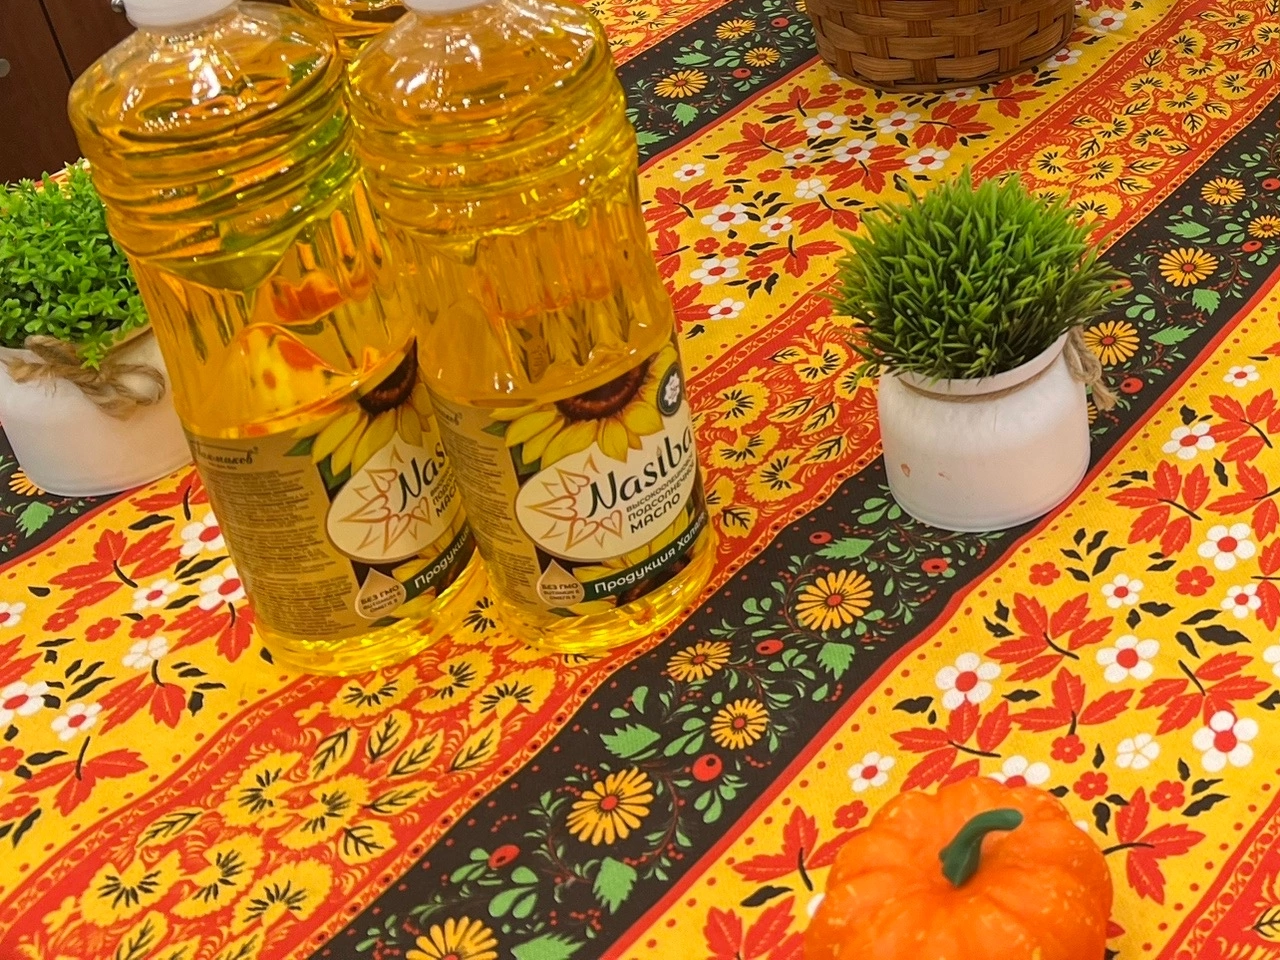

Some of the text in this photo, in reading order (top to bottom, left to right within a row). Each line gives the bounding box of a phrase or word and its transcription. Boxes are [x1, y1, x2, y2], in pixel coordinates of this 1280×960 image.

[586, 425, 693, 518] Nasiba
[629, 492, 681, 534] МАСЛО
[594, 547, 676, 593] Продукция
